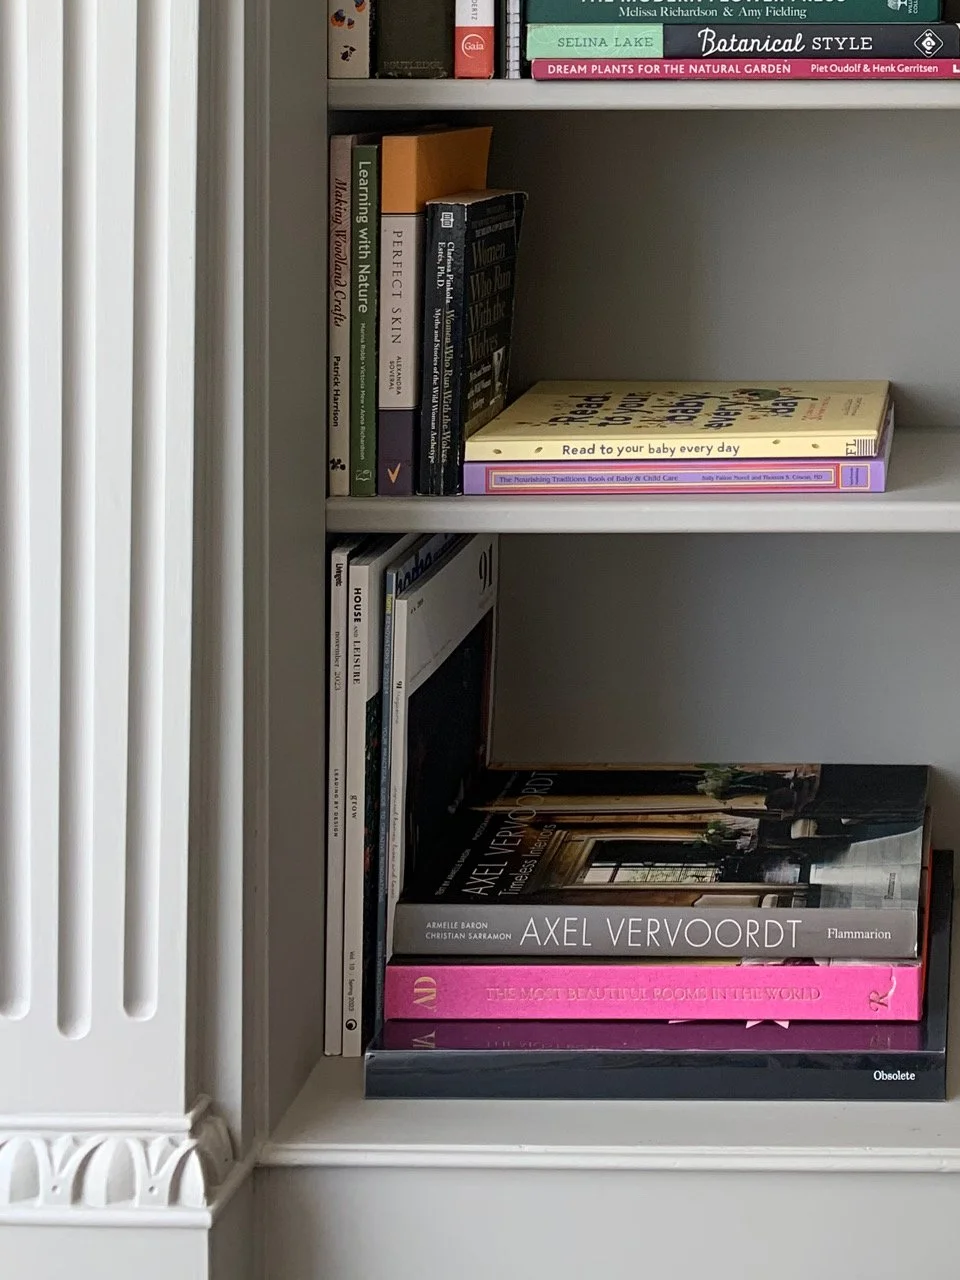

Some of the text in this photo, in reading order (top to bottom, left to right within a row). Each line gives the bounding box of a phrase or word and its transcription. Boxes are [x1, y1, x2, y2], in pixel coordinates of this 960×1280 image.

[557, 36, 654, 47] SELINA LAKE
[698, 27, 873, 56] Botanical STYLE
[548, 63, 792, 75] DREAM PLANTS FOR THE NATURAL GARDEN
[811, 63, 938, 73] Piet Oudolf & Henk Gerritsen
[355, 161, 372, 313] Learning with Nature
[332, 178, 349, 327] Making Woodland Crafts
[391, 230, 403, 345] PERFECT SKIN
[563, 443, 741, 457] Read to your baby every day
[519, 917, 802, 948] AXEL VERVOORDT
[827, 928, 892, 940] Flammarion
[873, 1070, 915, 1081] Obsolete
